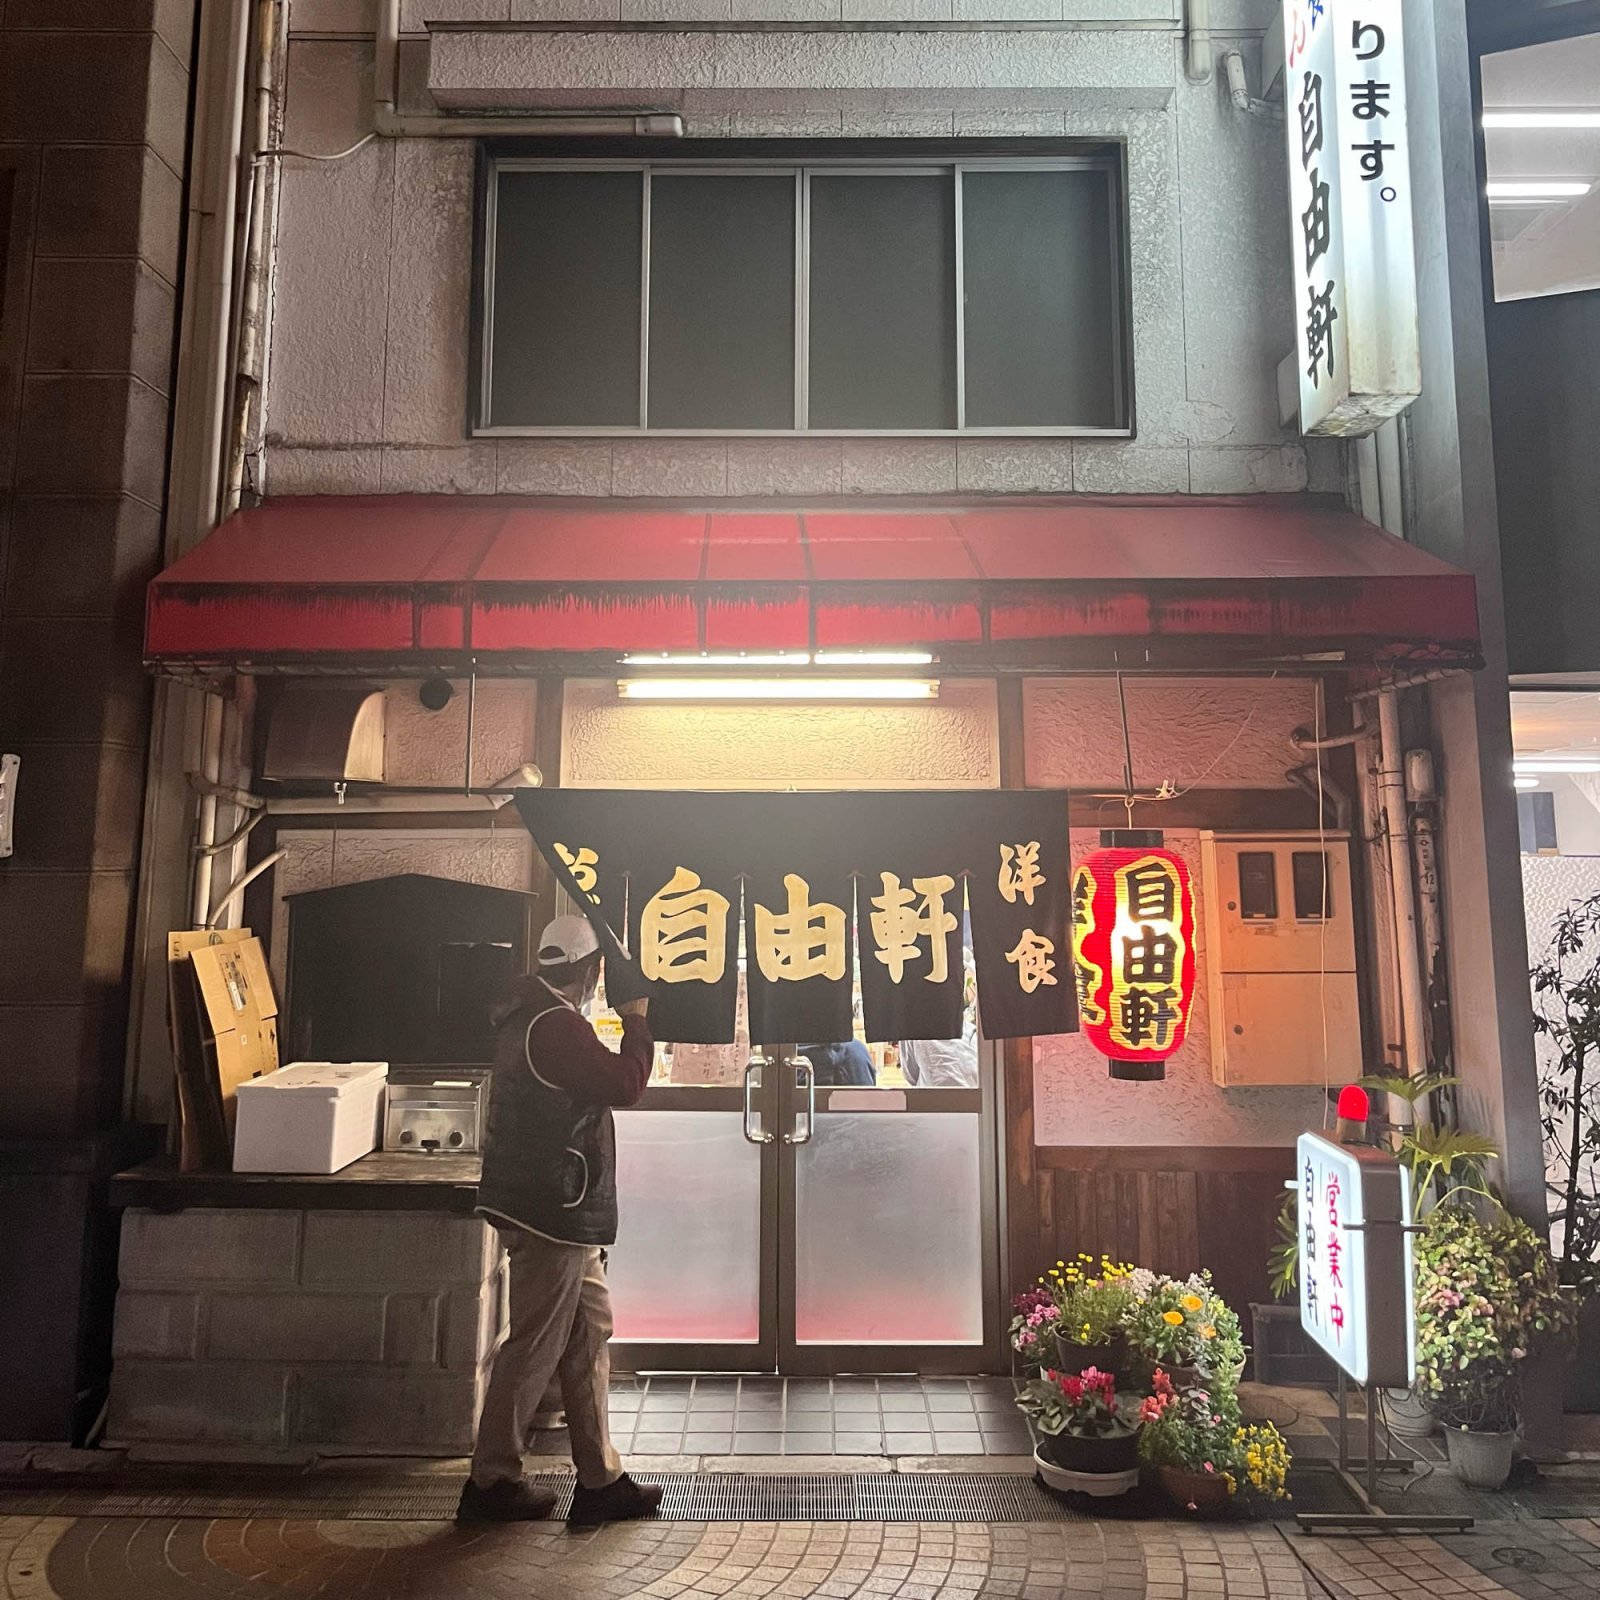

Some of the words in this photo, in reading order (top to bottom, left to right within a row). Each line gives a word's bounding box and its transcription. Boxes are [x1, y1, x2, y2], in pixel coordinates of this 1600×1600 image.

[1349, 19, 1397, 203] ります。
[1299, 70, 1338, 390] 自由軒
[640, 865, 958, 985] 自由軒
[998, 841, 1058, 994] 洋食
[1119, 861, 1178, 1047] 自由軒
[1325, 1170, 1345, 1348] 営業中
